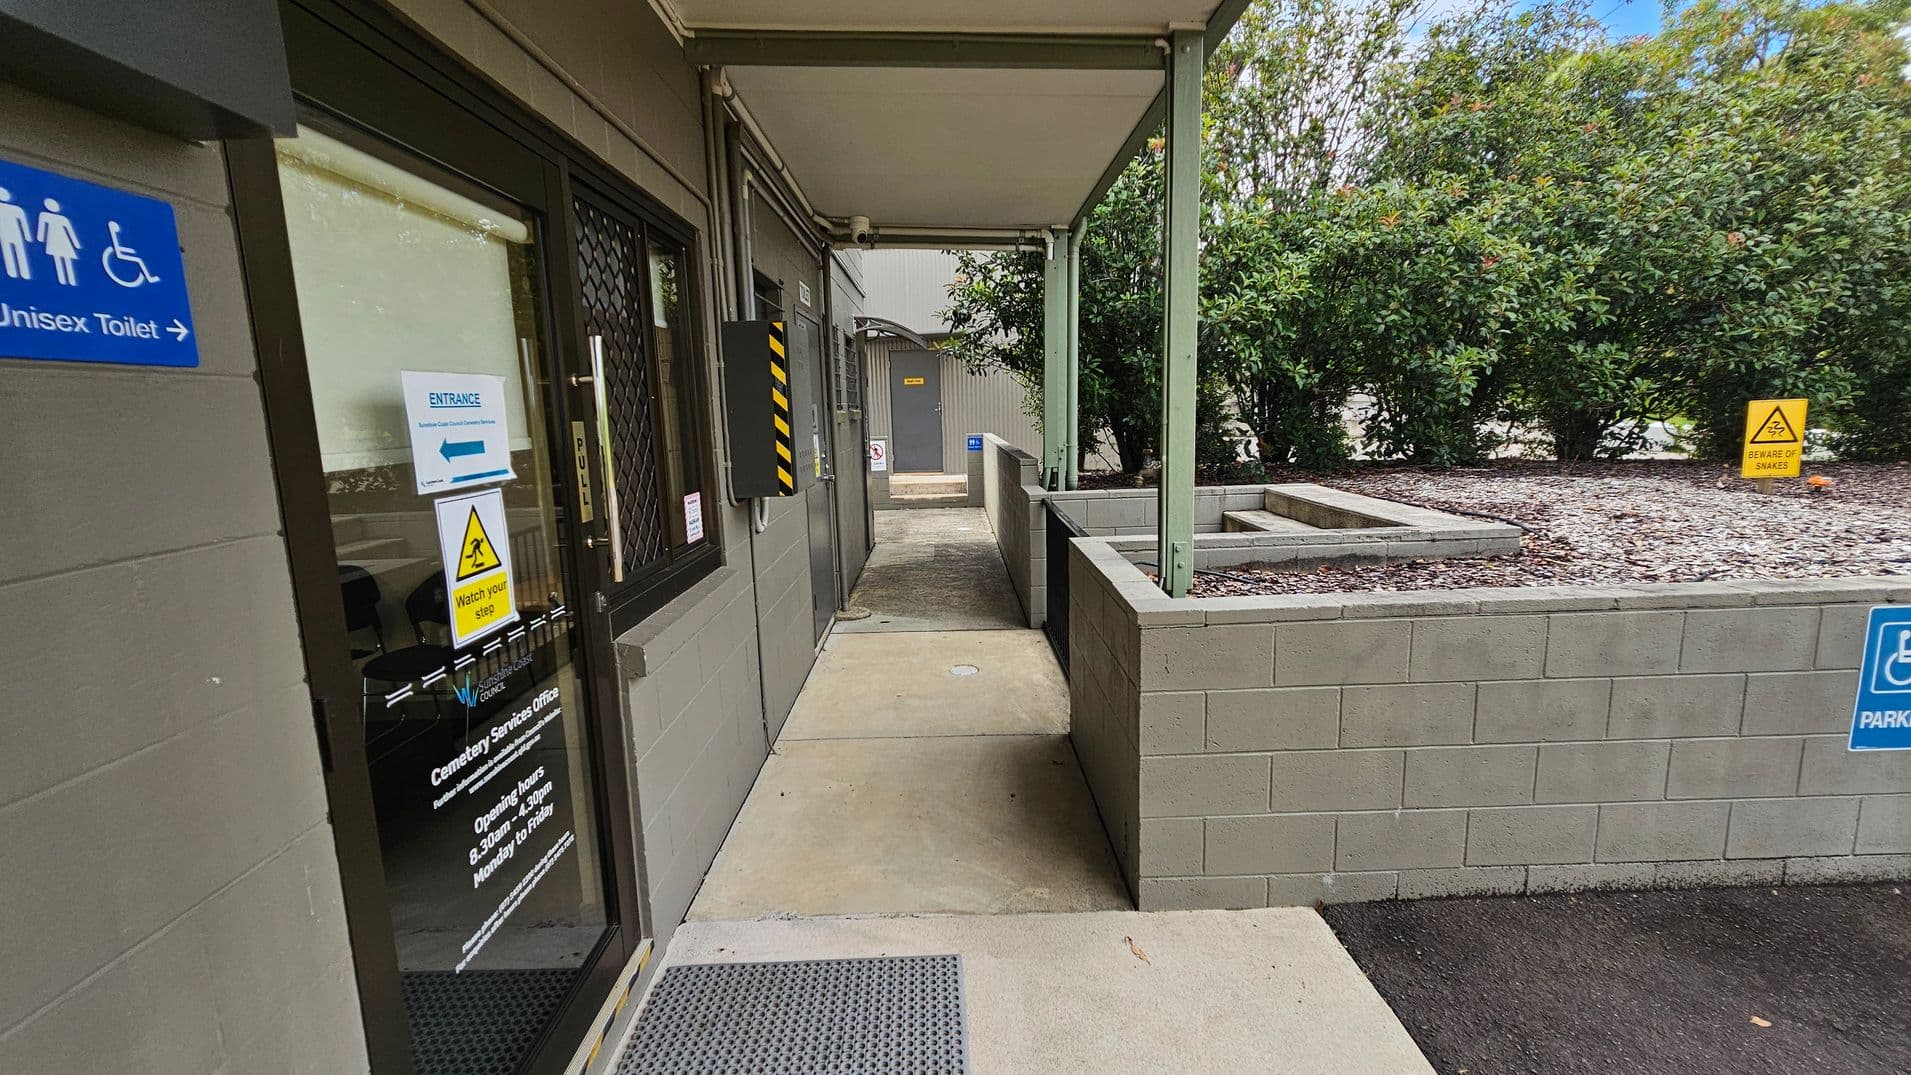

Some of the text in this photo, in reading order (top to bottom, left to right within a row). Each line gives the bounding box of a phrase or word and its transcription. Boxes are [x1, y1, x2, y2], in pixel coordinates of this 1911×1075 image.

[93, 313, 160, 339] Toilet
[429, 392, 481, 405] ENTRANCE
[1748, 450, 1797, 459] BEWARE OF
[1755, 461, 1788, 470] SNAKES
[577, 438, 589, 505] PULL
[456, 581, 507, 608] Watch your
[475, 604, 495, 620] step
[479, 652, 533, 692] Sunshine Coast
[480, 682, 506, 702] COUNCIL
[1859, 710, 1911, 728] PARK
[431, 687, 559, 786] Cemetery Services Office
[474, 766, 545, 834] Opening hours
[469, 820, 511, 865] 8.30am
[518, 781, 553, 817] 4.30pm
[473, 802, 554, 889] Monday to Friday
